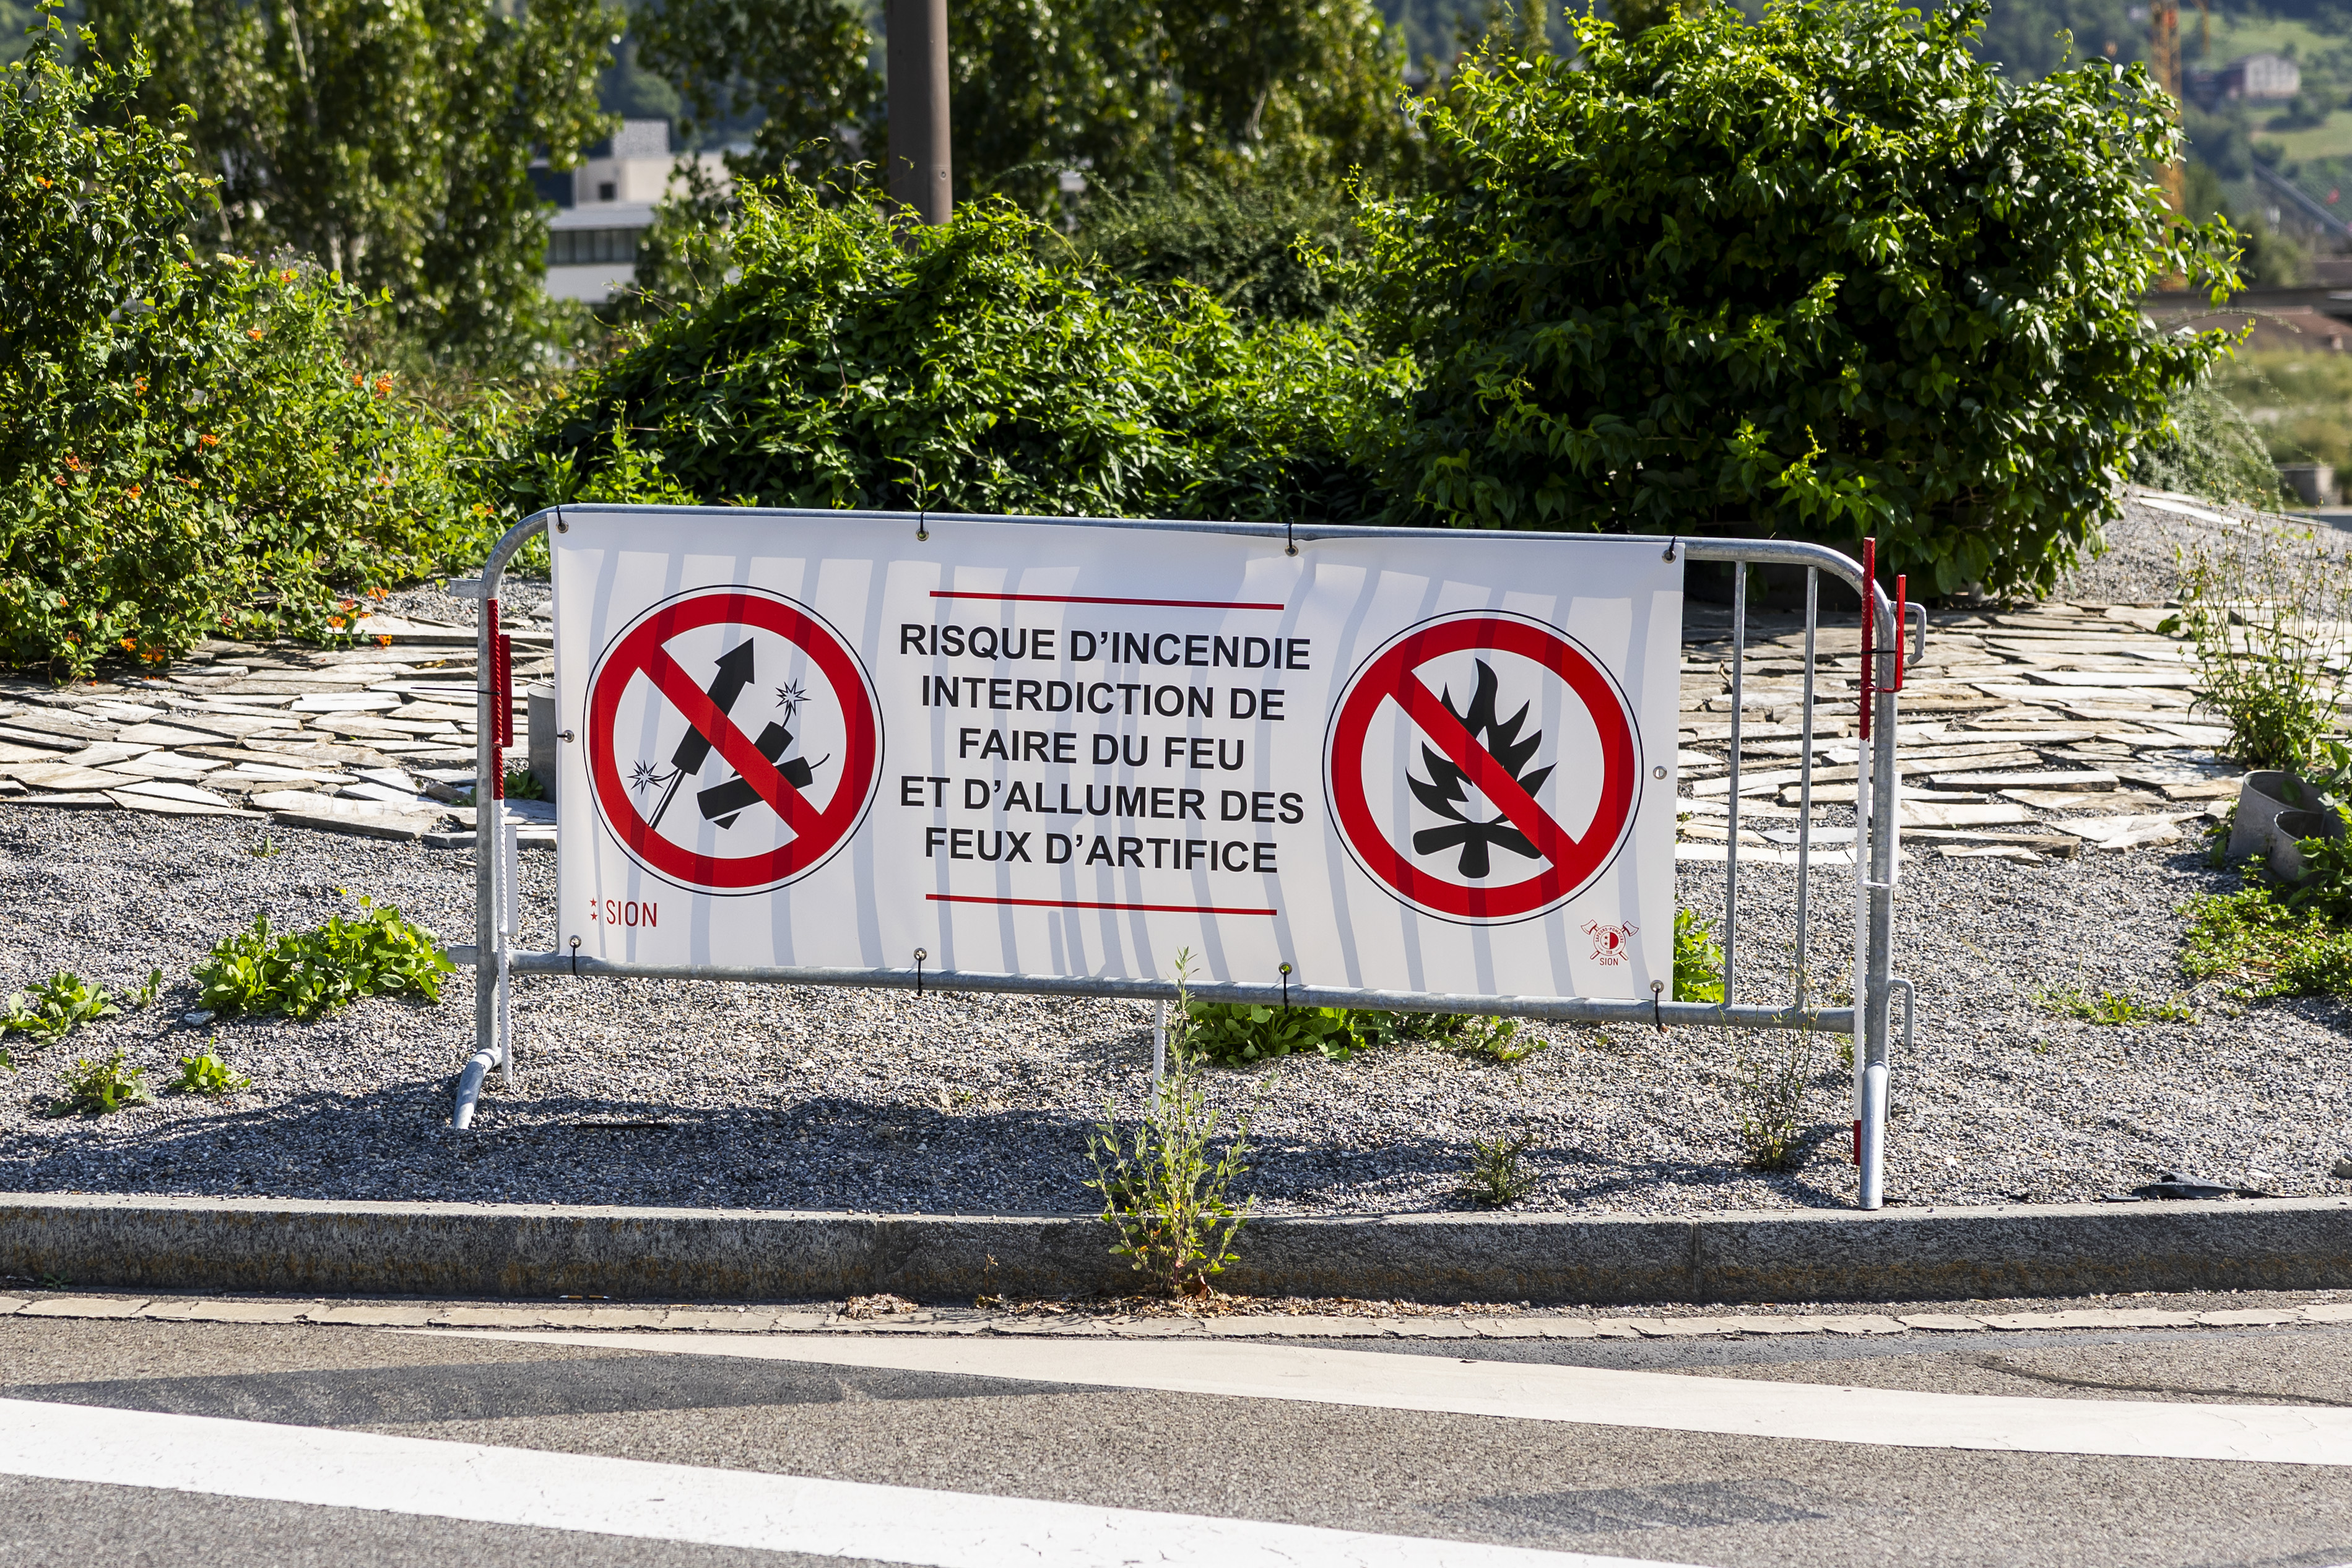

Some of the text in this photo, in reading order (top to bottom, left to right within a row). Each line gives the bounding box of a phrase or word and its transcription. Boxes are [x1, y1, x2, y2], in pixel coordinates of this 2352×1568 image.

[900, 623, 1311, 670] RISQUE D’INCENDIE
[922, 675, 1285, 721] INTERDICTION DE
[960, 727, 1244, 771] FAIRE DU FEU
[901, 776, 1304, 824] ET D’ALLUMER DES
[926, 826, 1278, 873] FEUX D’ARTIFICE
[605, 899, 657, 927] SION
[1600, 958, 1618, 966] SION
